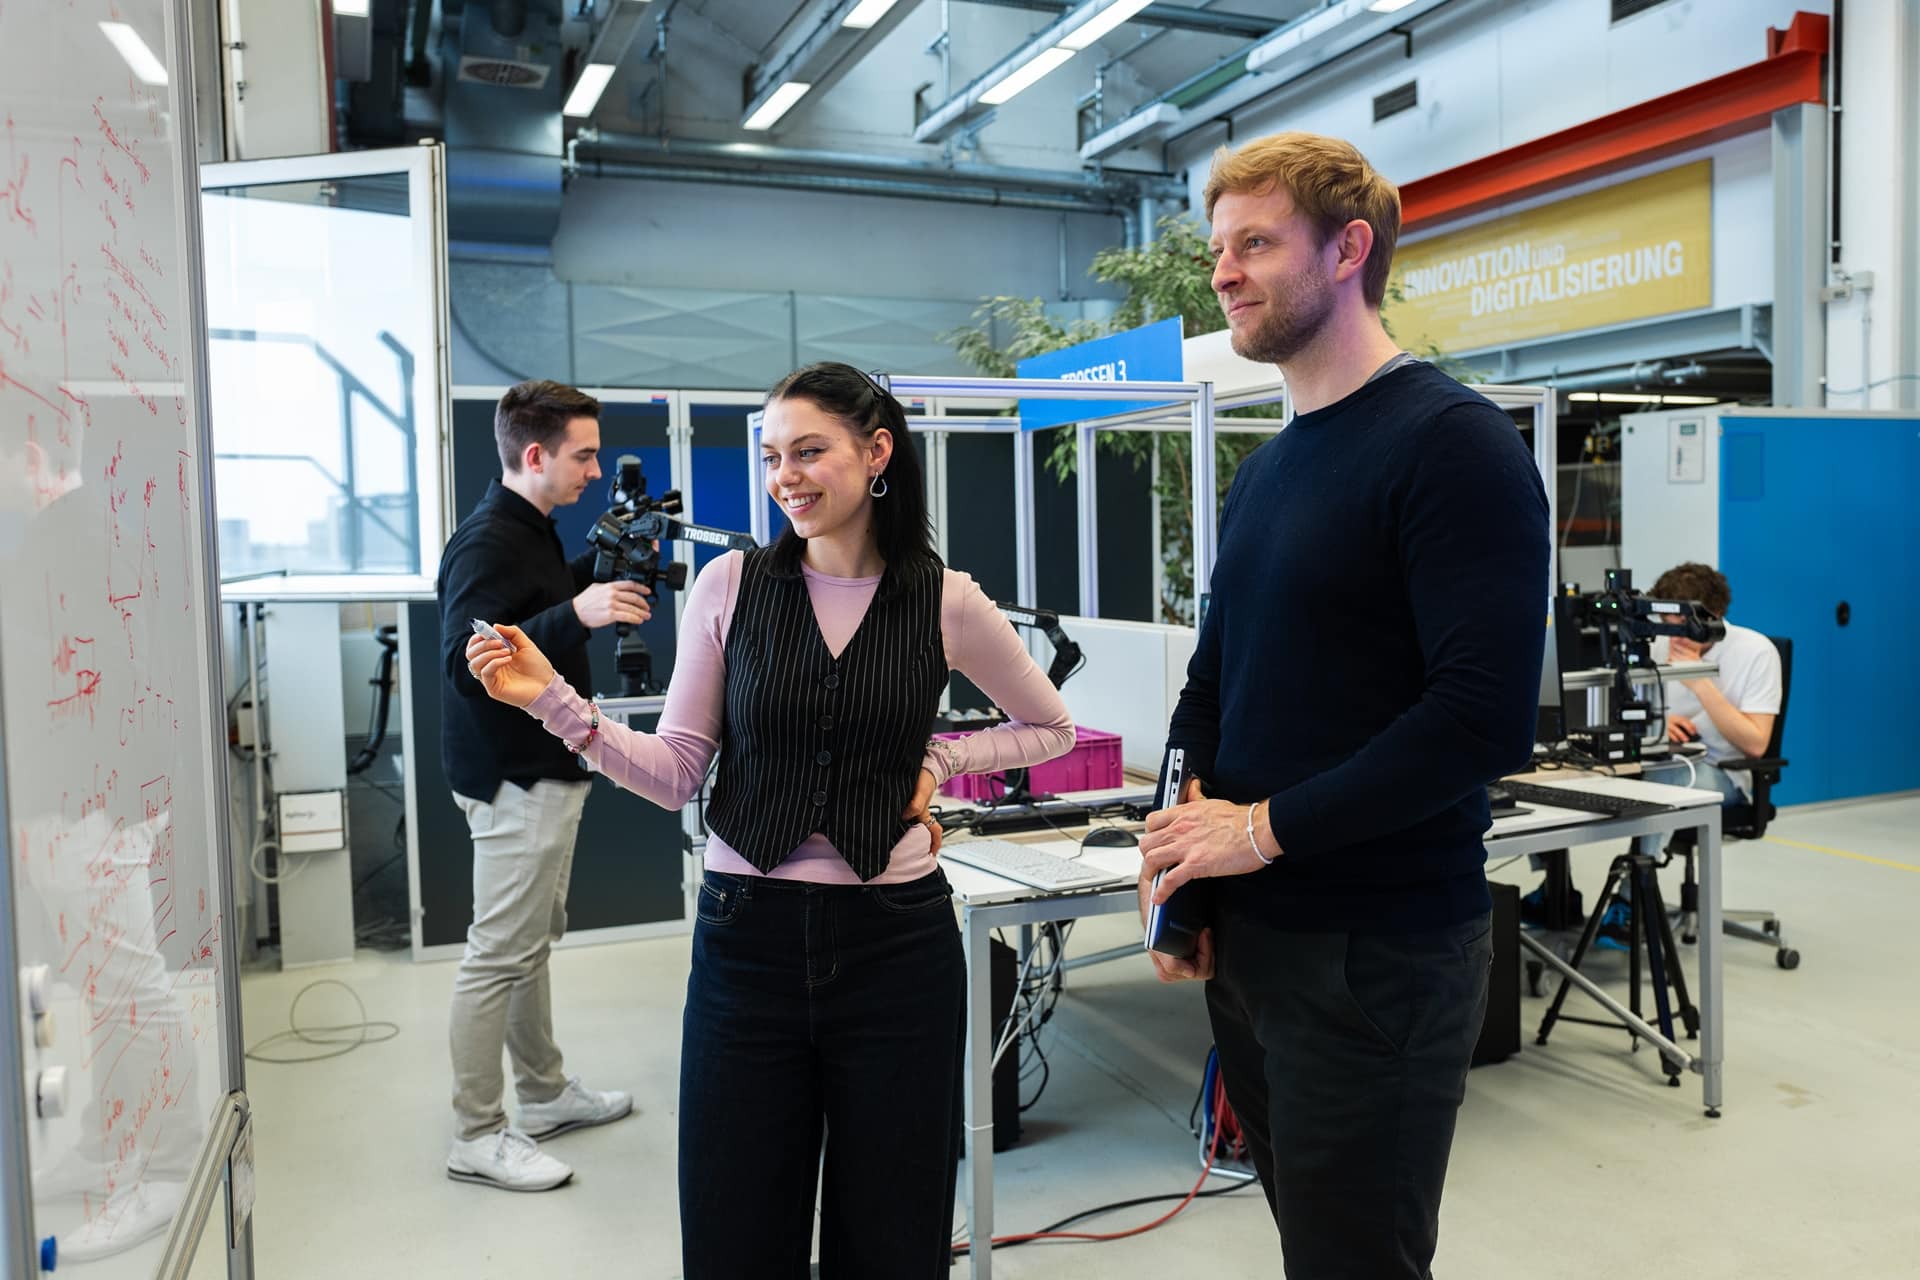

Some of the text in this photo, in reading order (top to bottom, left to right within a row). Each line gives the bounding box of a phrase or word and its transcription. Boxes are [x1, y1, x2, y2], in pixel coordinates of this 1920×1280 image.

[1404, 241, 1565, 300] INNOVATION UND
[1472, 241, 1682, 316] DIGITALISIERUNG
[684, 527, 729, 546] TROSSEN
